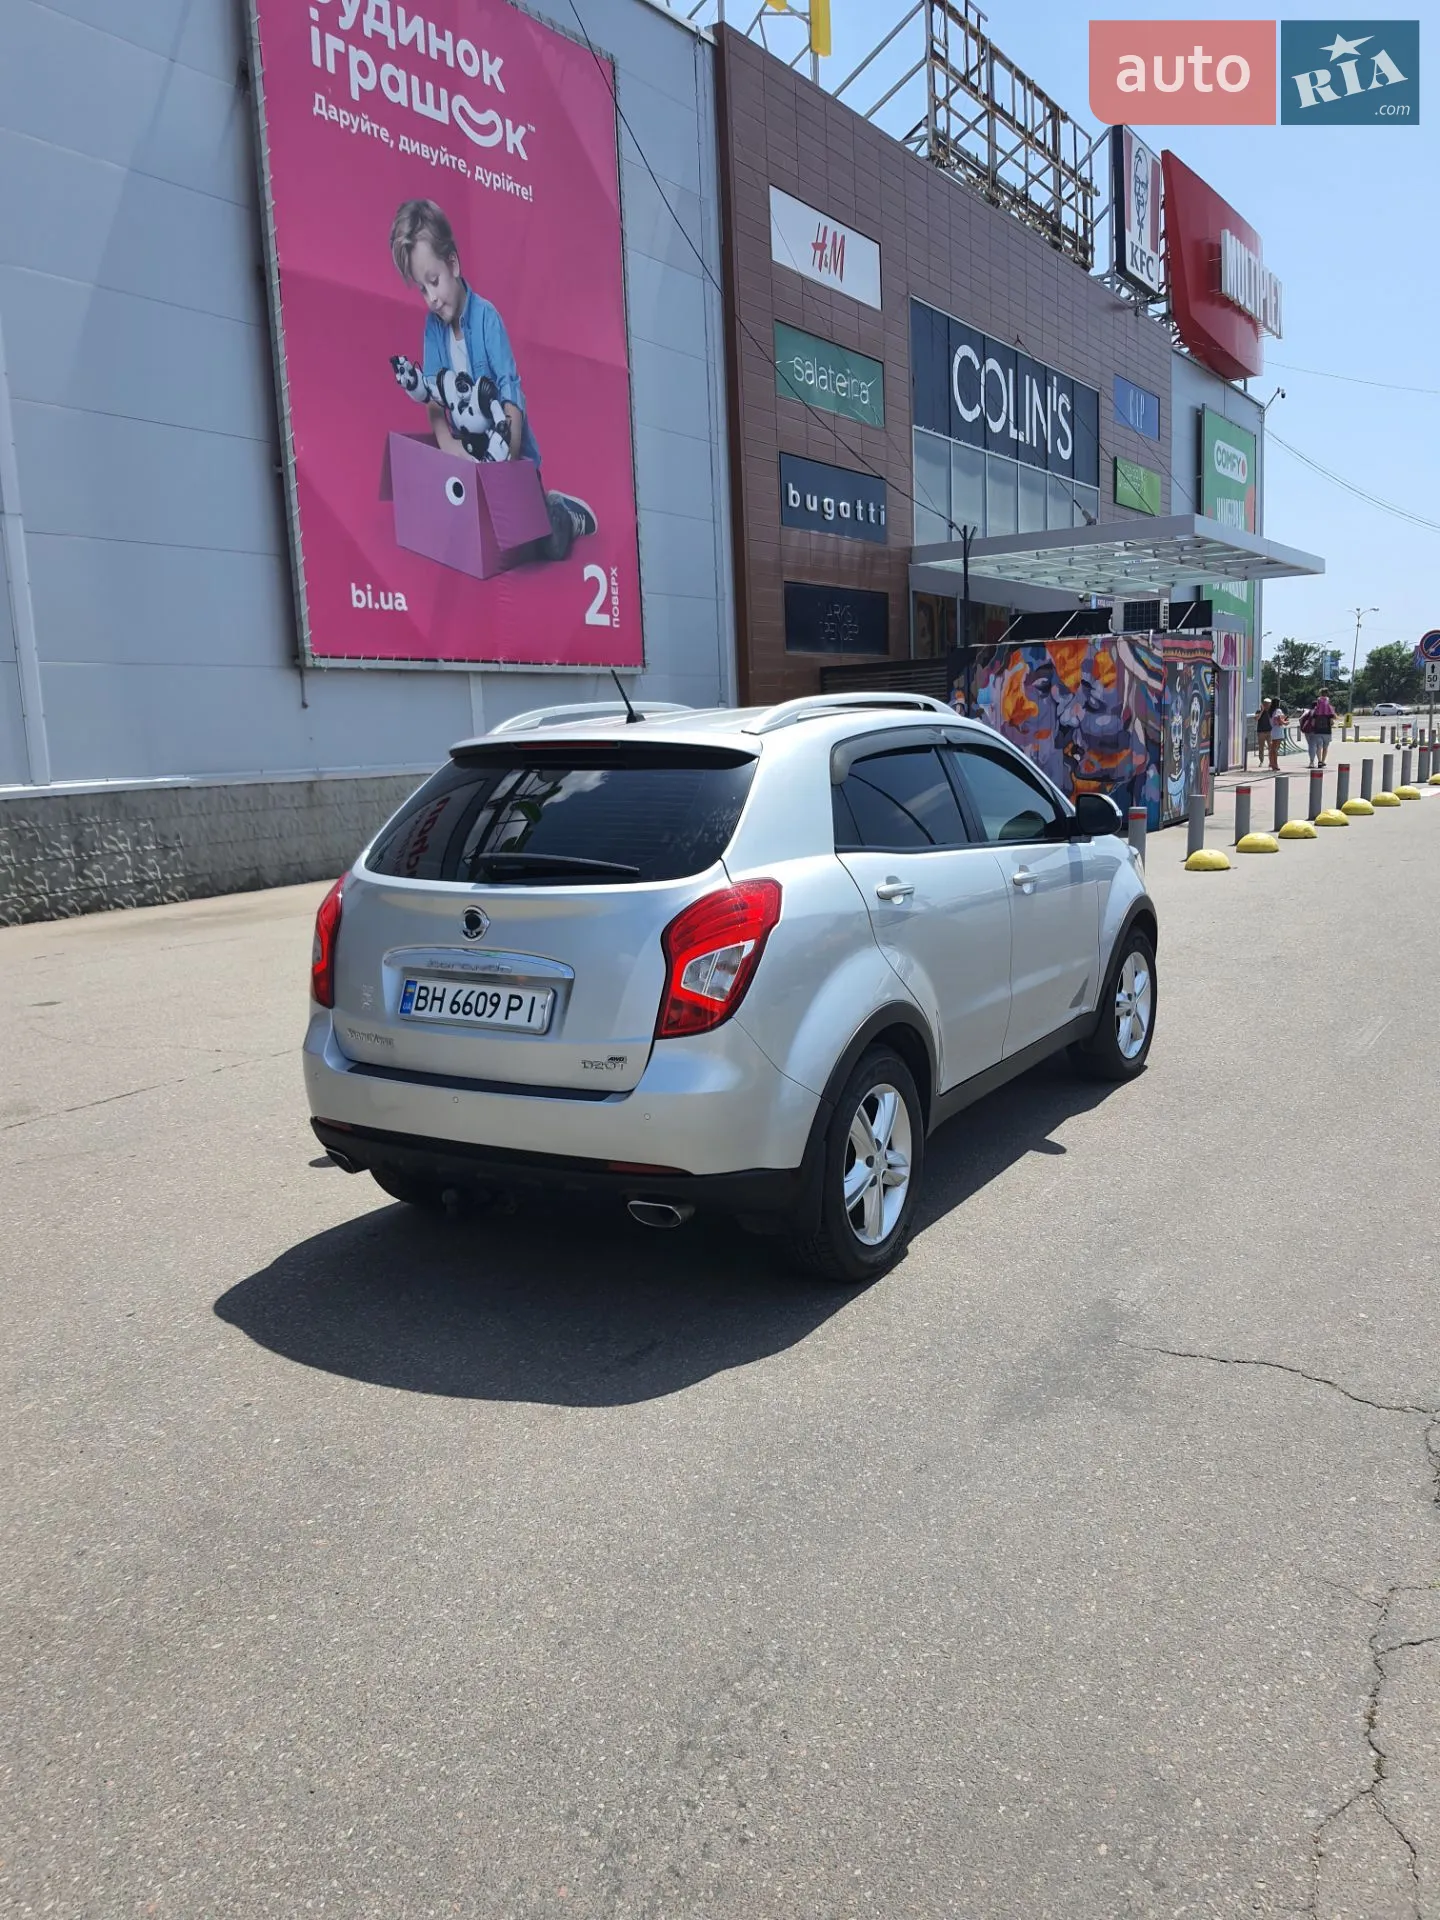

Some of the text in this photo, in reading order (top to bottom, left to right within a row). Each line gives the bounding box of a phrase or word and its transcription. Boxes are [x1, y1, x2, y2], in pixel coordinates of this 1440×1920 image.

[317, 0, 505, 93] удинок
[313, 91, 533, 203] Даруйте, дивуйте, дурійте!
[811, 222, 845, 283] H&M
[1129, 240, 1154, 283] KFC
[793, 355, 870, 405] salateira
[953, 344, 1073, 461] COLIN'S
[1216, 445, 1242, 476] COMFY
[787, 482, 886, 526] bugatti
[350, 582, 409, 612] bi.ua
[583, 563, 612, 627] 2
[610, 566, 620, 628] ПОВЕРХ
[1427, 674, 1438, 683] 50
[414, 985, 536, 1023] BH 6609 PI
